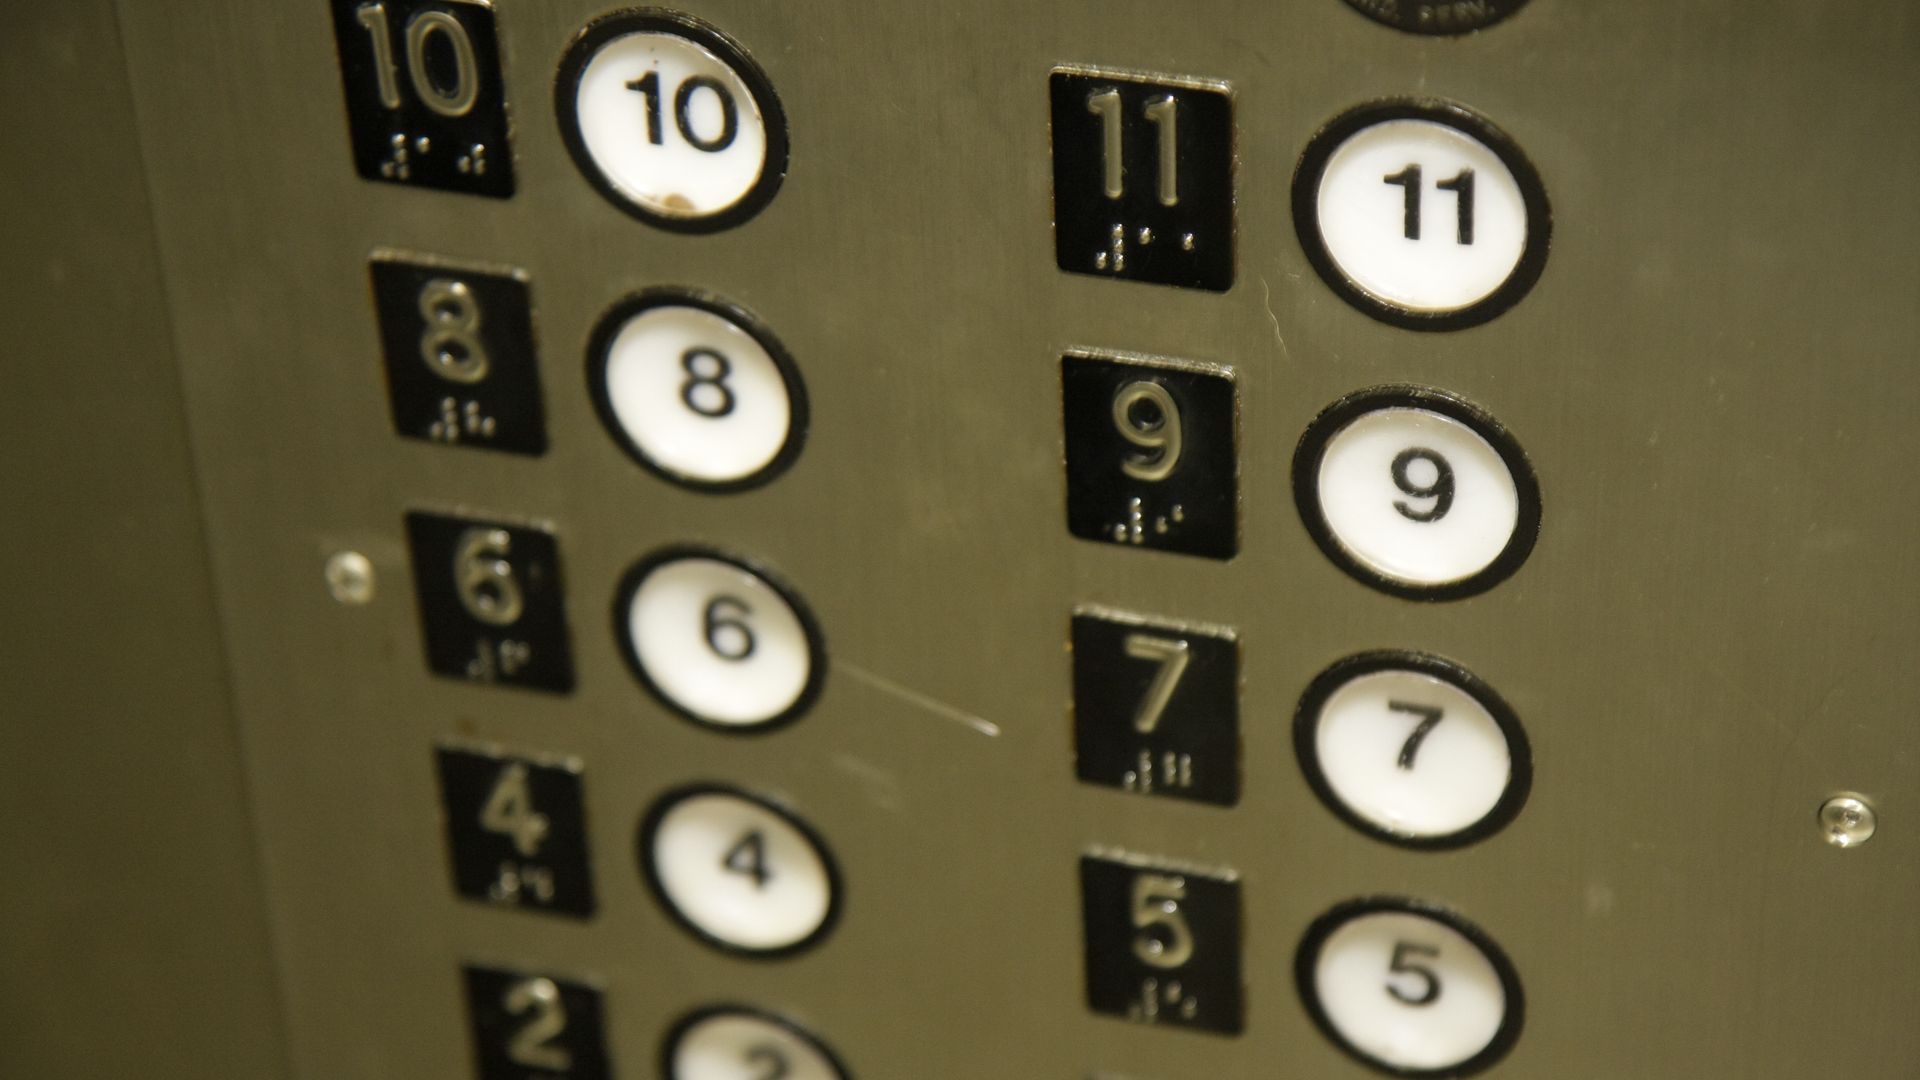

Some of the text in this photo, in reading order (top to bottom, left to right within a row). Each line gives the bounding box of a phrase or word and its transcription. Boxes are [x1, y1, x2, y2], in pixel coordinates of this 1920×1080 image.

[356, 3, 479, 117] 10
[625, 71, 739, 153] 10
[1088, 88, 1179, 206] 11
[1383, 163, 1476, 246] 11
[418, 278, 489, 385] 8
[680, 346, 737, 418] 8
[1112, 380, 1183, 482] 9
[1390, 446, 1456, 523] 9
[453, 527, 524, 627] 6
[703, 595, 757, 662] 6
[1124, 634, 1190, 734] 7
[1387, 697, 1444, 771] 7
[479, 761, 550, 857] 4
[720, 828, 773, 890] 4
[1130, 873, 1194, 969] 5
[1384, 940, 1442, 1008] 5
[504, 976, 572, 1071] 2
[743, 1043, 791, 1080] 2
